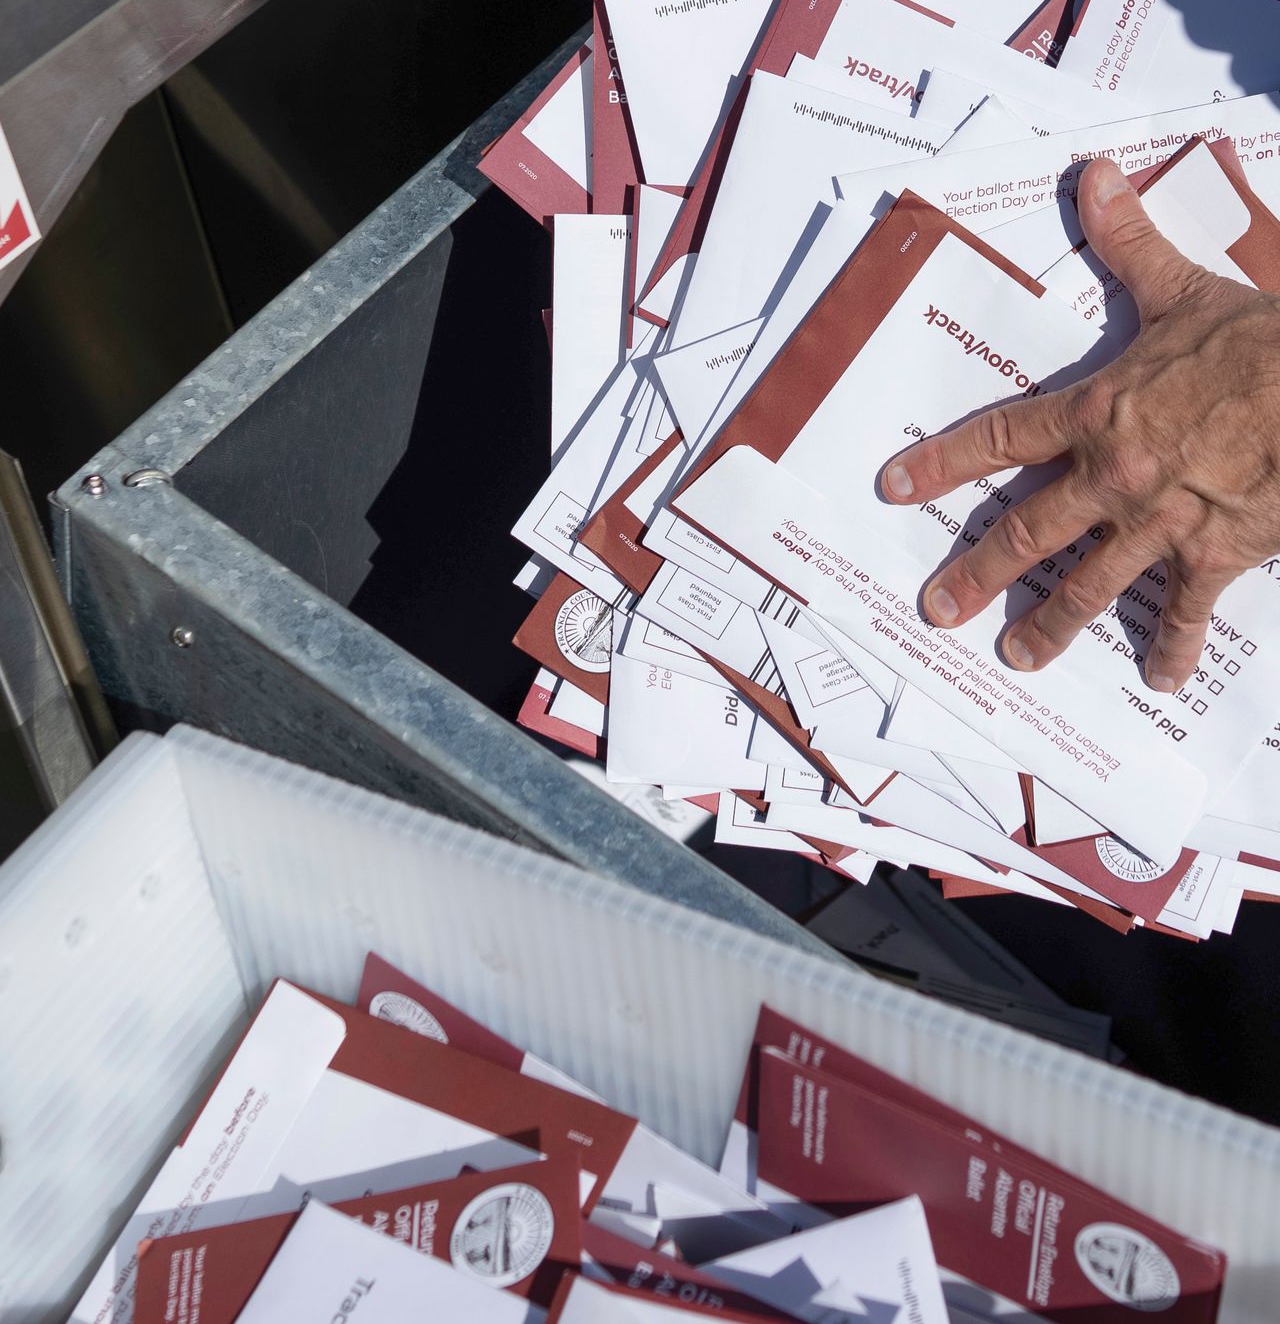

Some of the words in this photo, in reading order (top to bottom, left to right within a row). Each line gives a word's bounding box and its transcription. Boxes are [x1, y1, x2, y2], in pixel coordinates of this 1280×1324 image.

[1096, 57, 1111, 79] the
[1107, 30, 1123, 56] day
[1114, 22, 1142, 72] Election
[1108, 74, 1121, 91] on
[1071, 149, 1116, 164] Return
[1118, 142, 1147, 158] your
[1150, 133, 1187, 149] ballot
[1191, 127, 1228, 144] early.
[943, 190, 973, 203] Your
[977, 182, 1014, 198] ballot
[1018, 175, 1052, 190] must
[1056, 171, 1073, 184] be
[1125, 154, 1155, 170] and
[1241, 136, 1257, 149] by
[946, 202, 998, 218] Election
[1002, 196, 1029, 209] Day
[1032, 192, 1046, 203] or
[1256, 149, 1273, 160] on
[900, 231, 918, 253] 07.2020
[1078, 286, 1097, 305] the
[1084, 305, 1100, 320] on
[616, 530, 640, 554] 07.2020
[687, 531, 722, 555] First-Class
[781, 519, 807, 541] Day.
[773, 532, 812, 562] before
[808, 538, 853, 572] Election
[811, 559, 835, 576] day
[853, 569, 870, 583] on
[690, 583, 722, 606] Required
[835, 574, 856, 592] the
[866, 581, 898, 602] p.m.
[679, 596, 713, 621] First-Class
[690, 594, 717, 614] Postage
[854, 590, 872, 604] by
[895, 601, 919, 622] 7:30
[556, 605, 570, 646] FRANKLIN
[869, 601, 941, 652] postmarked
[871, 617, 899, 641] early.
[899, 639, 932, 668] ballot
[936, 629, 978, 660] person
[1110, 635, 1146, 667] and
[931, 664, 960, 686] your
[937, 651, 964, 677] and
[975, 658, 988, 672] in
[958, 669, 1004, 700] mailed
[986, 668, 1037, 706] returned
[725, 696, 739, 726] Did
[958, 683, 996, 716] Return
[1004, 699, 1021, 715] be
[1036, 705, 1051, 717] or
[1121, 687, 1162, 720] you...
[1020, 710, 1051, 736] must
[1049, 715, 1075, 737] Day
[1156, 718, 1188, 742] Did
[1050, 733, 1084, 763] ballot
[1076, 734, 1121, 770] Election
[1083, 760, 1109, 783] Your
[1115, 867, 1157, 880] FRANKLIN
[1185, 866, 1204, 901] First-Class
[968, 1156, 986, 1202] Ballot
[993, 1168, 1012, 1237] Absentee
[1043, 1192, 1062, 1243] Return
[1035, 1245, 1055, 1305] Envelope
